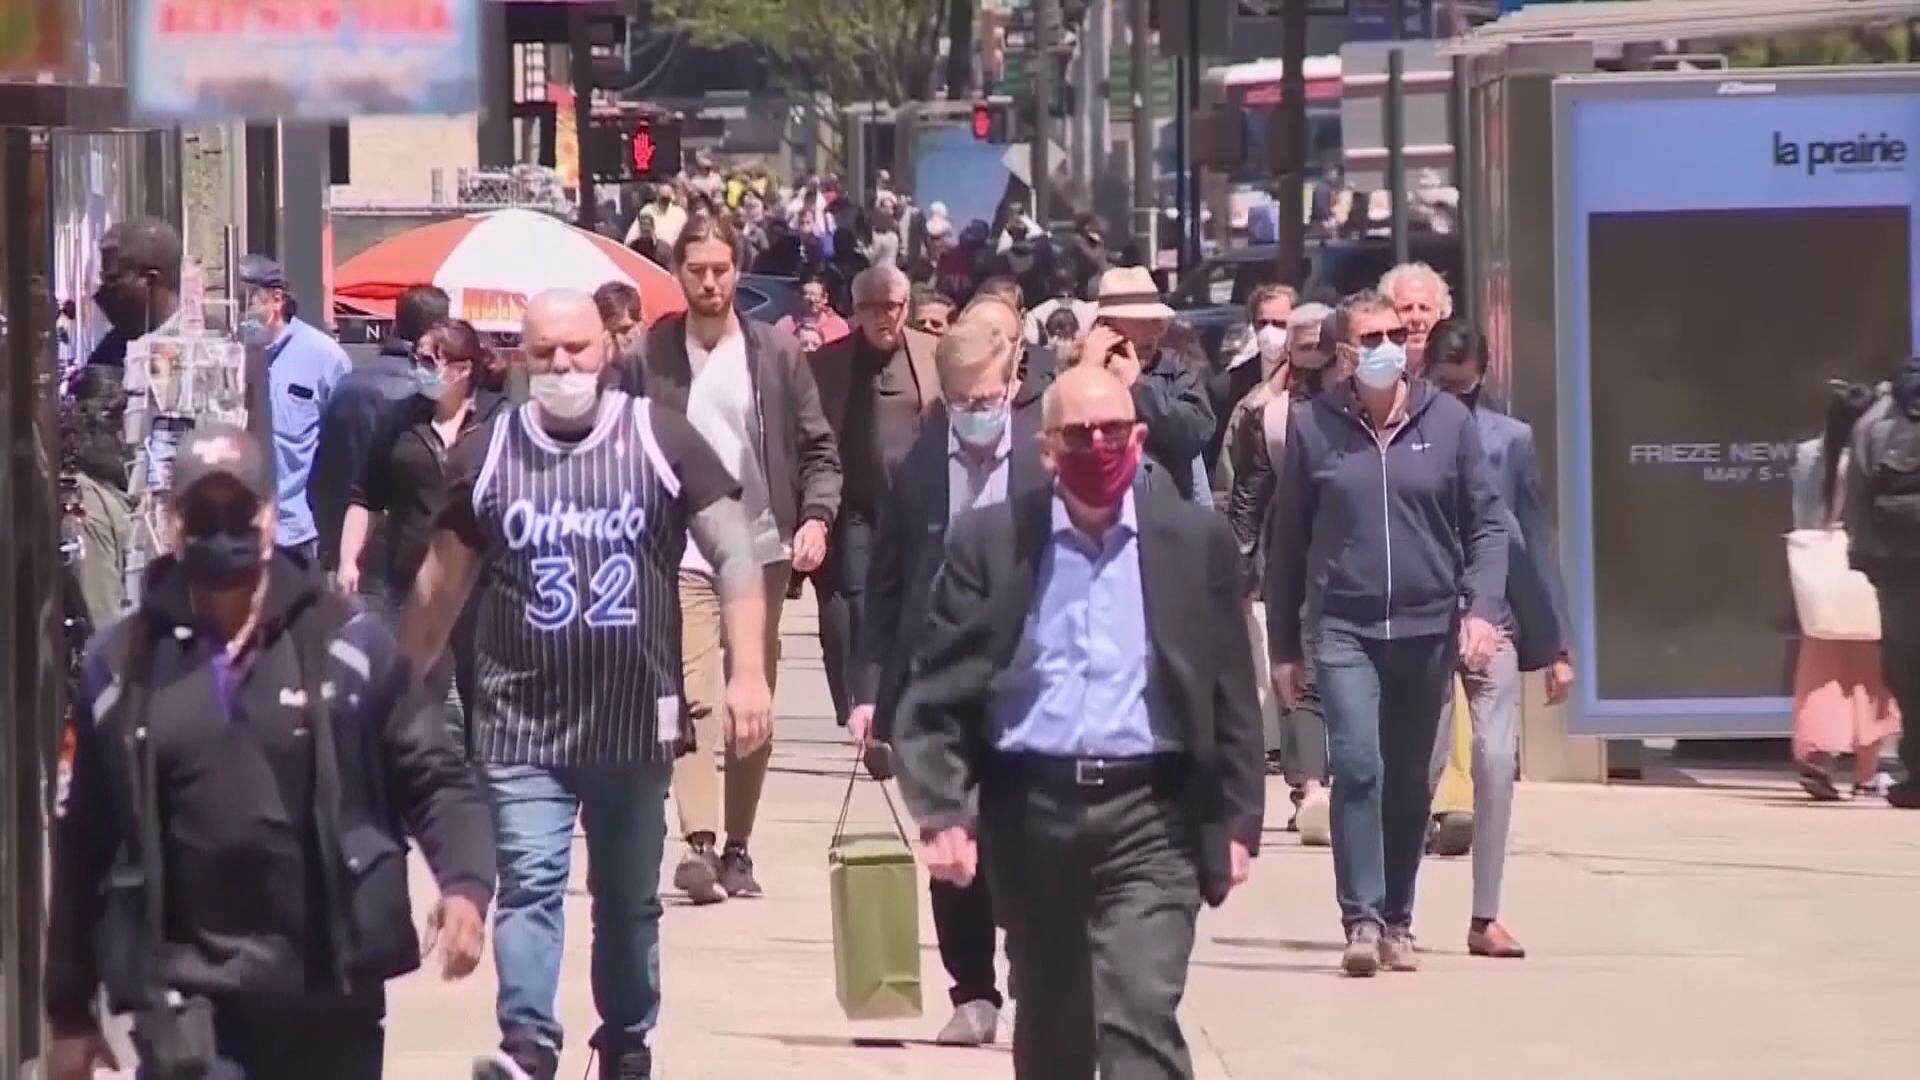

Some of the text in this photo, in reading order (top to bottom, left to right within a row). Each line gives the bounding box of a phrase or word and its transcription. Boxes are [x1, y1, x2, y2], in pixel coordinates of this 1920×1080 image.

[1773, 131, 1907, 175] la prairie
[1630, 442, 1794, 464] FRIEZE NEW
[1703, 466, 1751, 482] MAY
[525, 553, 637, 630] 32
